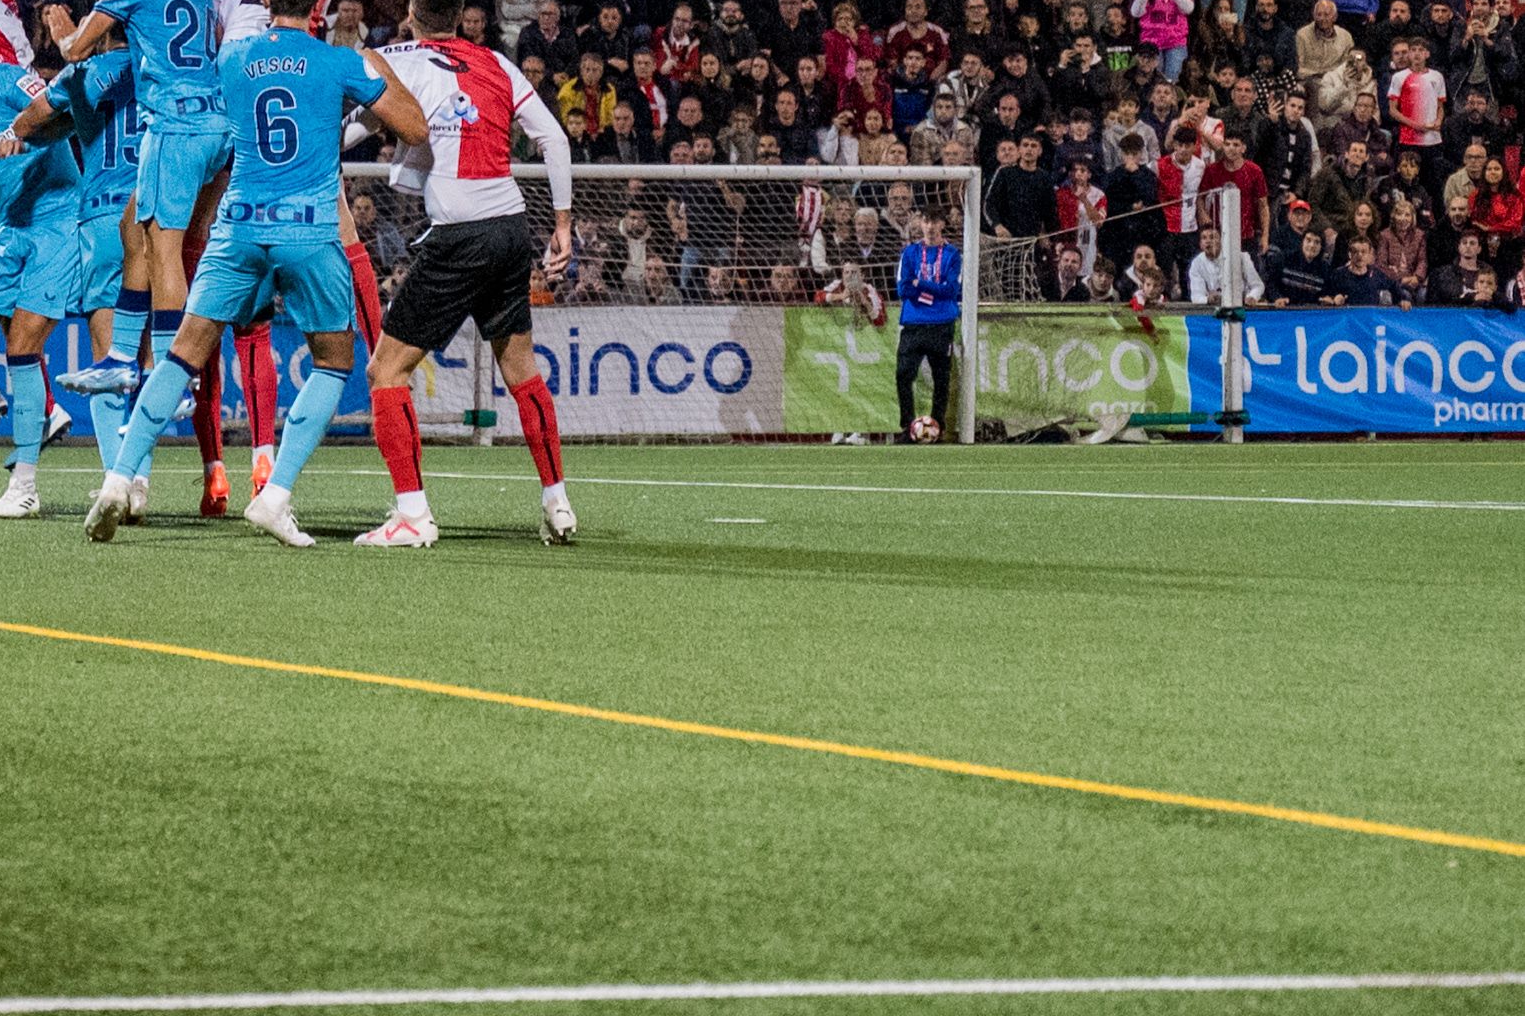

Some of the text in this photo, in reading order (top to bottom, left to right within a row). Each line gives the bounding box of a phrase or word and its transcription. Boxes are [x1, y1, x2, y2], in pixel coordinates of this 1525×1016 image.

[244, 56, 308, 82] VESGA
[94, 99, 148, 170] 15
[253, 86, 299, 166] 6
